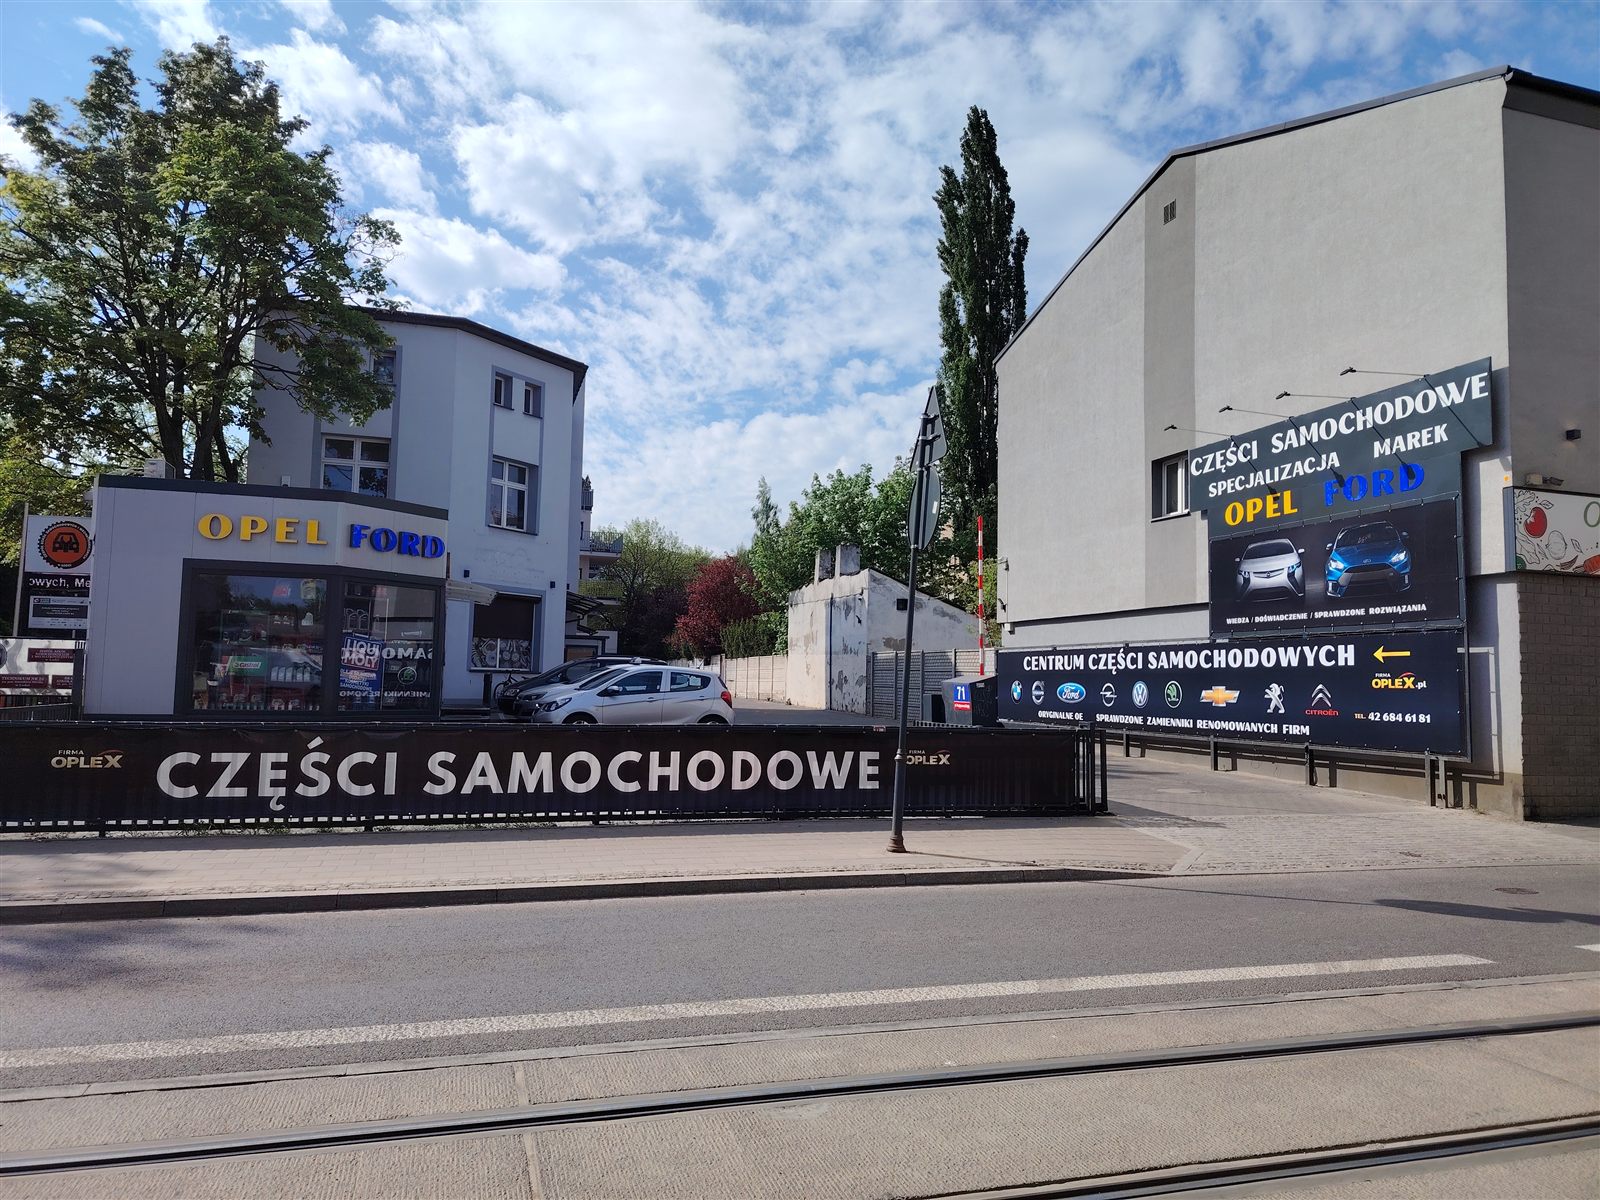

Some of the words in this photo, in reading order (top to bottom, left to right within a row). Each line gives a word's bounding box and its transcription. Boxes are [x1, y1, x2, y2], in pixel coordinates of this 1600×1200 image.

[1190, 440, 1259, 477] CZĘŚCI
[1271, 372, 1490, 453] SAMOCHODOWE
[1208, 451, 1341, 498] SPECJALIZACJA
[1373, 423, 1449, 459] MAREK
[1224, 489, 1298, 527] OPEL
[1324, 462, 1425, 507] FORD
[198, 513, 328, 545] OPEL
[349, 523, 446, 559] FORD
[1226, 616, 1250, 624] WIEDZA
[1254, 612, 1308, 623] DOŚWIADCZENIE
[1314, 608, 1366, 619] SPRAWDZONE
[1368, 603, 1427, 614] ROZWIĄZANIA
[1023, 654, 1084, 671] CENTRUM
[1088, 648, 1143, 675] CZĘŚCI
[1147, 644, 1355, 670] SAMOCHODOWYCH
[956, 686, 966, 700] 71
[1038, 710, 1074, 720] ORYGINALNE
[1075, 712, 1084, 721] OE
[1096, 714, 1144, 725] SPRAWDZONE
[1146, 716, 1193, 728] ZAMIENNIKI
[1196, 720, 1278, 734] RENOMOWANYCH
[1282, 725, 1310, 736] FIRM
[1368, 712, 1380, 721] 42
[1382, 712, 1402, 722] 684
[1405, 714, 1416, 722] 61
[1418, 714, 1431, 723] 81
[50, 754, 123, 768] OPLEX
[156, 736, 398, 811] CZĘŚCI
[422, 750, 881, 795] SAMOCHODOWE
[906, 754, 951, 765] OPLEX
